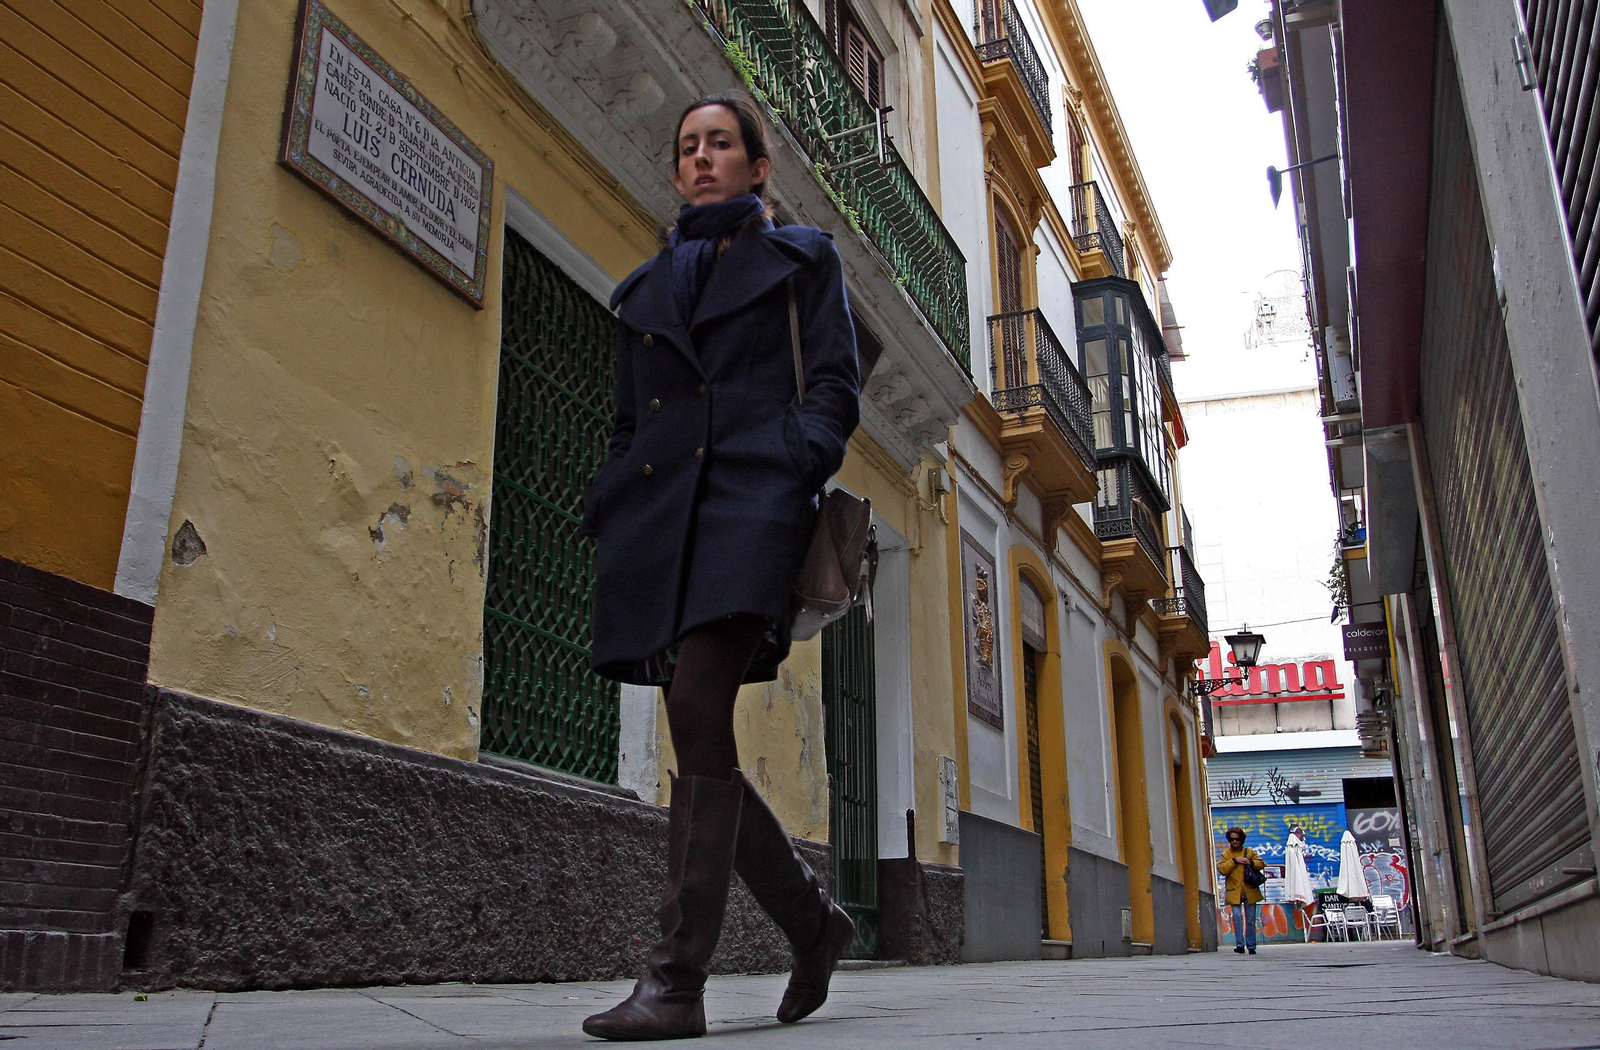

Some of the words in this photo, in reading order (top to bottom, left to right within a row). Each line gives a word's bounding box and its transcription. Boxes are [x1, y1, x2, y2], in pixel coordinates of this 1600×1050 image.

[314, 119, 324, 134] EL
[326, 129, 351, 155] POETA
[353, 150, 391, 186] EJEMPLAR
[324, 77, 356, 113] NACIO
[359, 106, 373, 127] EL
[375, 121, 387, 139] 21
[398, 139, 451, 192] SEPTIEMBRE
[460, 193, 476, 215] 1902
[329, 43, 344, 67] EN
[347, 61, 372, 92] ESTA
[378, 89, 403, 119] CASA
[441, 146, 476, 184] ANTIGUA
[358, 89, 387, 121] CONDE
[428, 148, 445, 171] HOY
[342, 111, 381, 158] LUIS
[391, 152, 456, 223] CERNUDA
[404, 205, 411, 217] A
[411, 210, 420, 223] SU
[421, 218, 456, 252] MEMORIA
[1324, 894, 1340, 902] BAR
